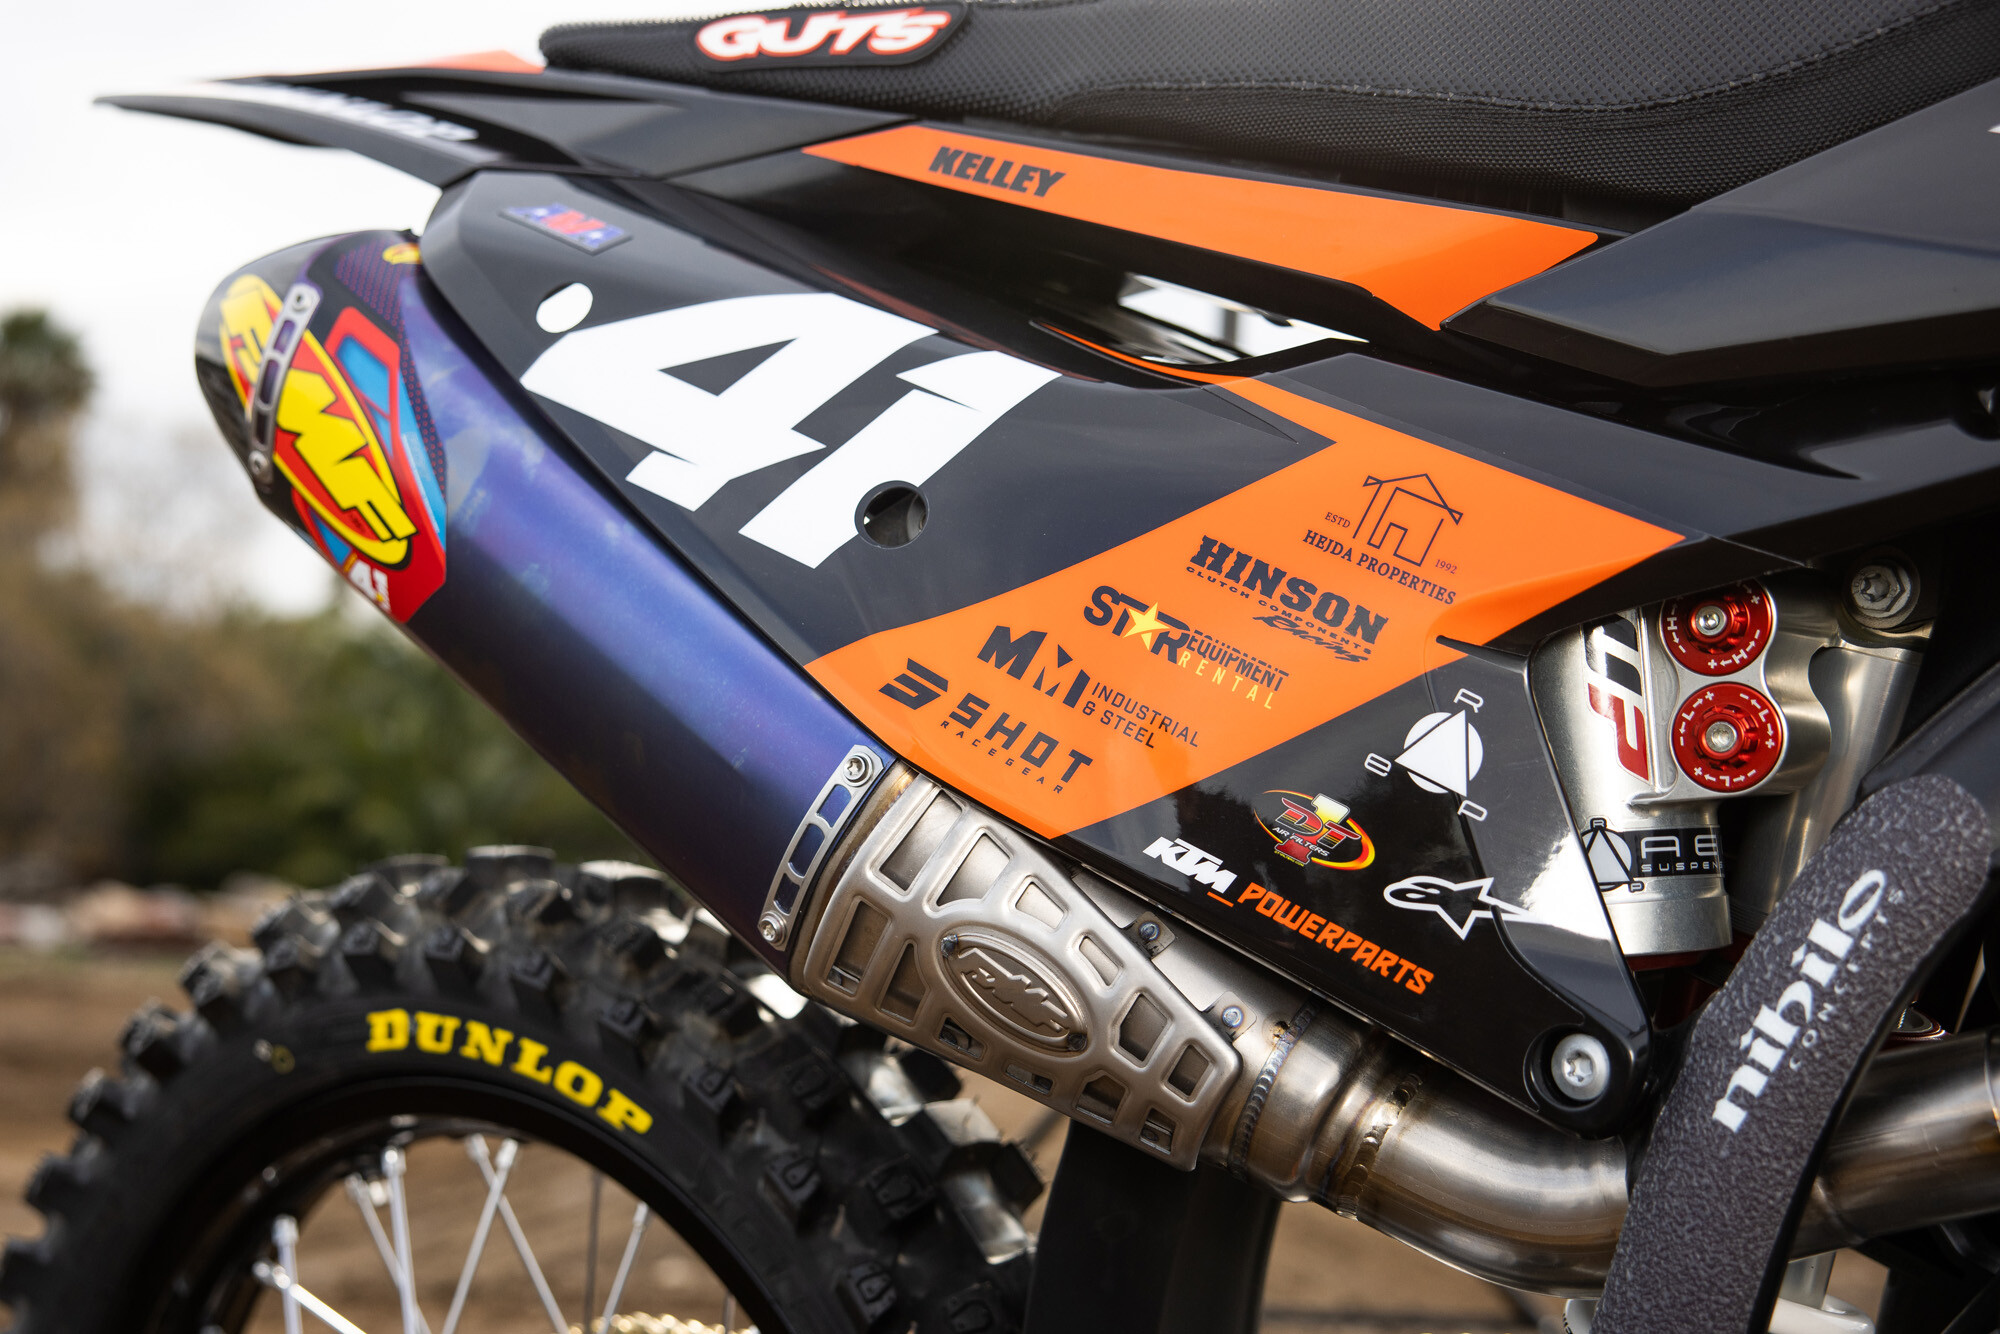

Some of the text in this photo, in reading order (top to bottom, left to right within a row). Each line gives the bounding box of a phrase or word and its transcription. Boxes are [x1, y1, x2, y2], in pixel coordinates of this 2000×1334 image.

[696, 7, 952, 62] GUTS
[928, 146, 1067, 198] KELLEY
[520, 292, 1062, 569] 41
[1302, 529, 1457, 605] HEJDA PROPERTIES
[1324, 511, 1458, 575] ESTD 1992
[1186, 565, 1372, 655] CLUTCH COMPONENTS
[1189, 534, 1389, 645] HINSON
[1178, 650, 1274, 710] RENTAL
[1186, 629, 1290, 692] EQUIPMENT
[948, 692, 1094, 784] SHOT
[1082, 700, 1155, 749] & STEEL
[1091, 681, 1199, 748] INDUSTRIAL
[940, 720, 1064, 795] RACEGEAR
[1142, 836, 1239, 895] KTM
[1272, 826, 1331, 857] AIR FILTERS
[366, 1008, 654, 1135] DUNLOP
